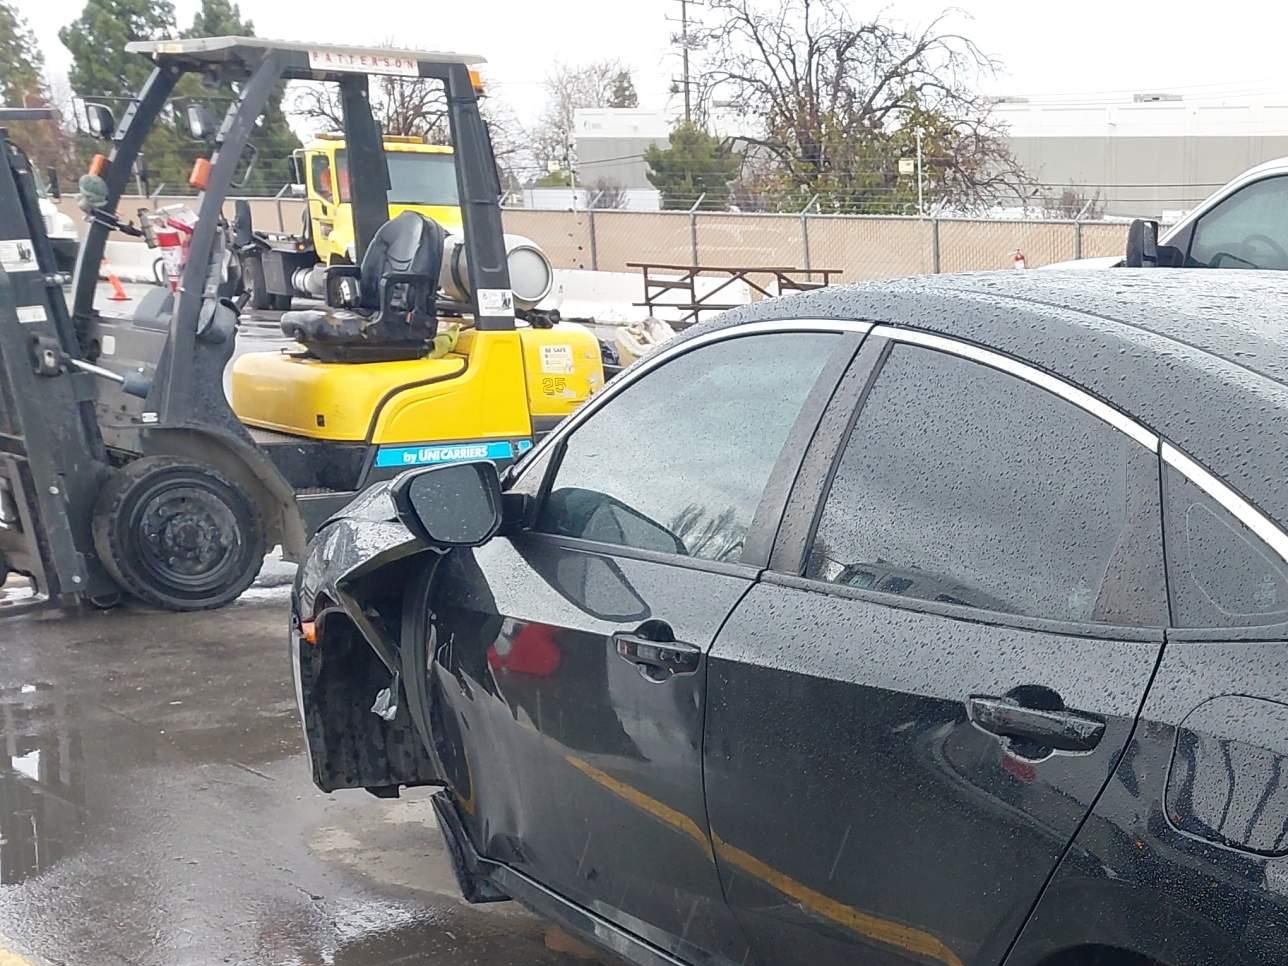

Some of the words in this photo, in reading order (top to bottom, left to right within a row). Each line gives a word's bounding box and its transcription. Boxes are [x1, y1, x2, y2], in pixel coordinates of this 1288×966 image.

[312, 51, 414, 69] PATTERSON
[542, 377, 567, 396] 25
[402, 451, 417, 464] by
[418, 446, 488, 462] UNICARRIERS
